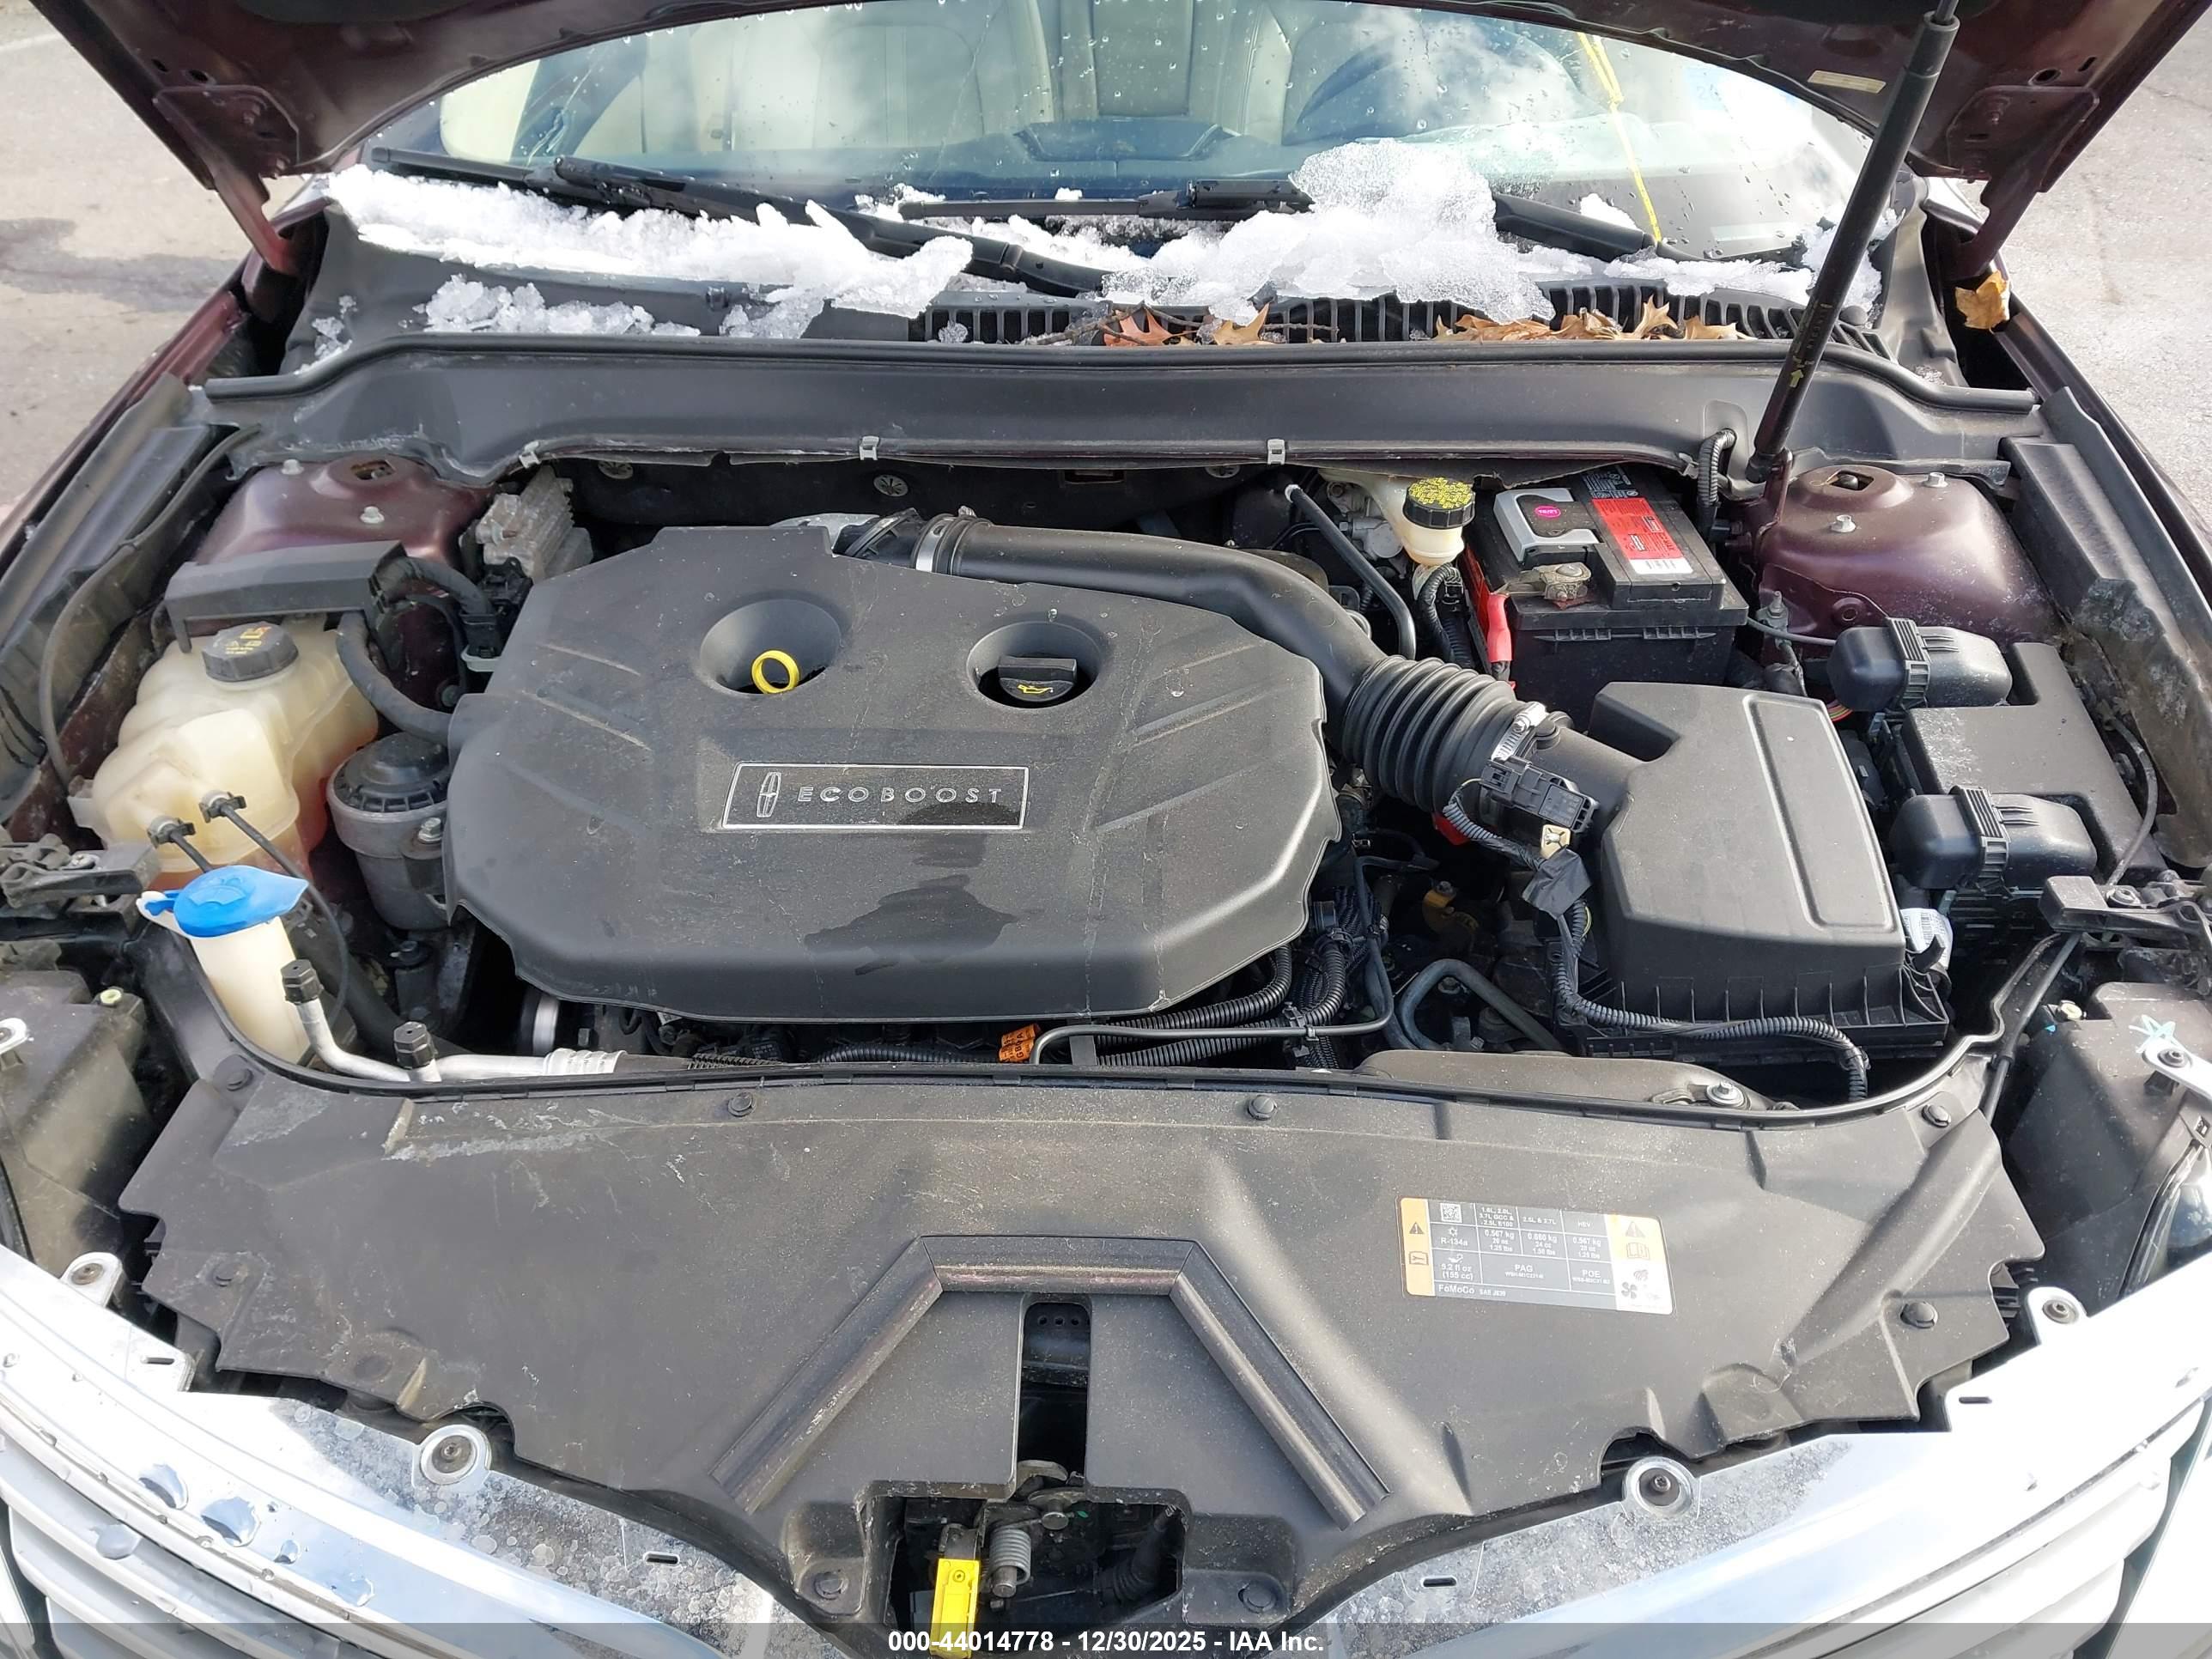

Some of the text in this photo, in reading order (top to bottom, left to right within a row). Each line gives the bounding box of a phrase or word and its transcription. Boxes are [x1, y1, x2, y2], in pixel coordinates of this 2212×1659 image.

[797, 786, 1003, 804] ECOBOOST
[1504, 1231, 1515, 1240] kg
[1547, 1234, 1558, 1243] kg
[1441, 1237, 1468, 1247] R-134a
[1592, 1238, 1601, 1248] kg
[1515, 1264, 1534, 1273] PAG
[1442, 1271, 1460, 1279] (155
[1582, 1269, 1601, 1279] POE
[1438, 1284, 1475, 1294] FoMoCo
